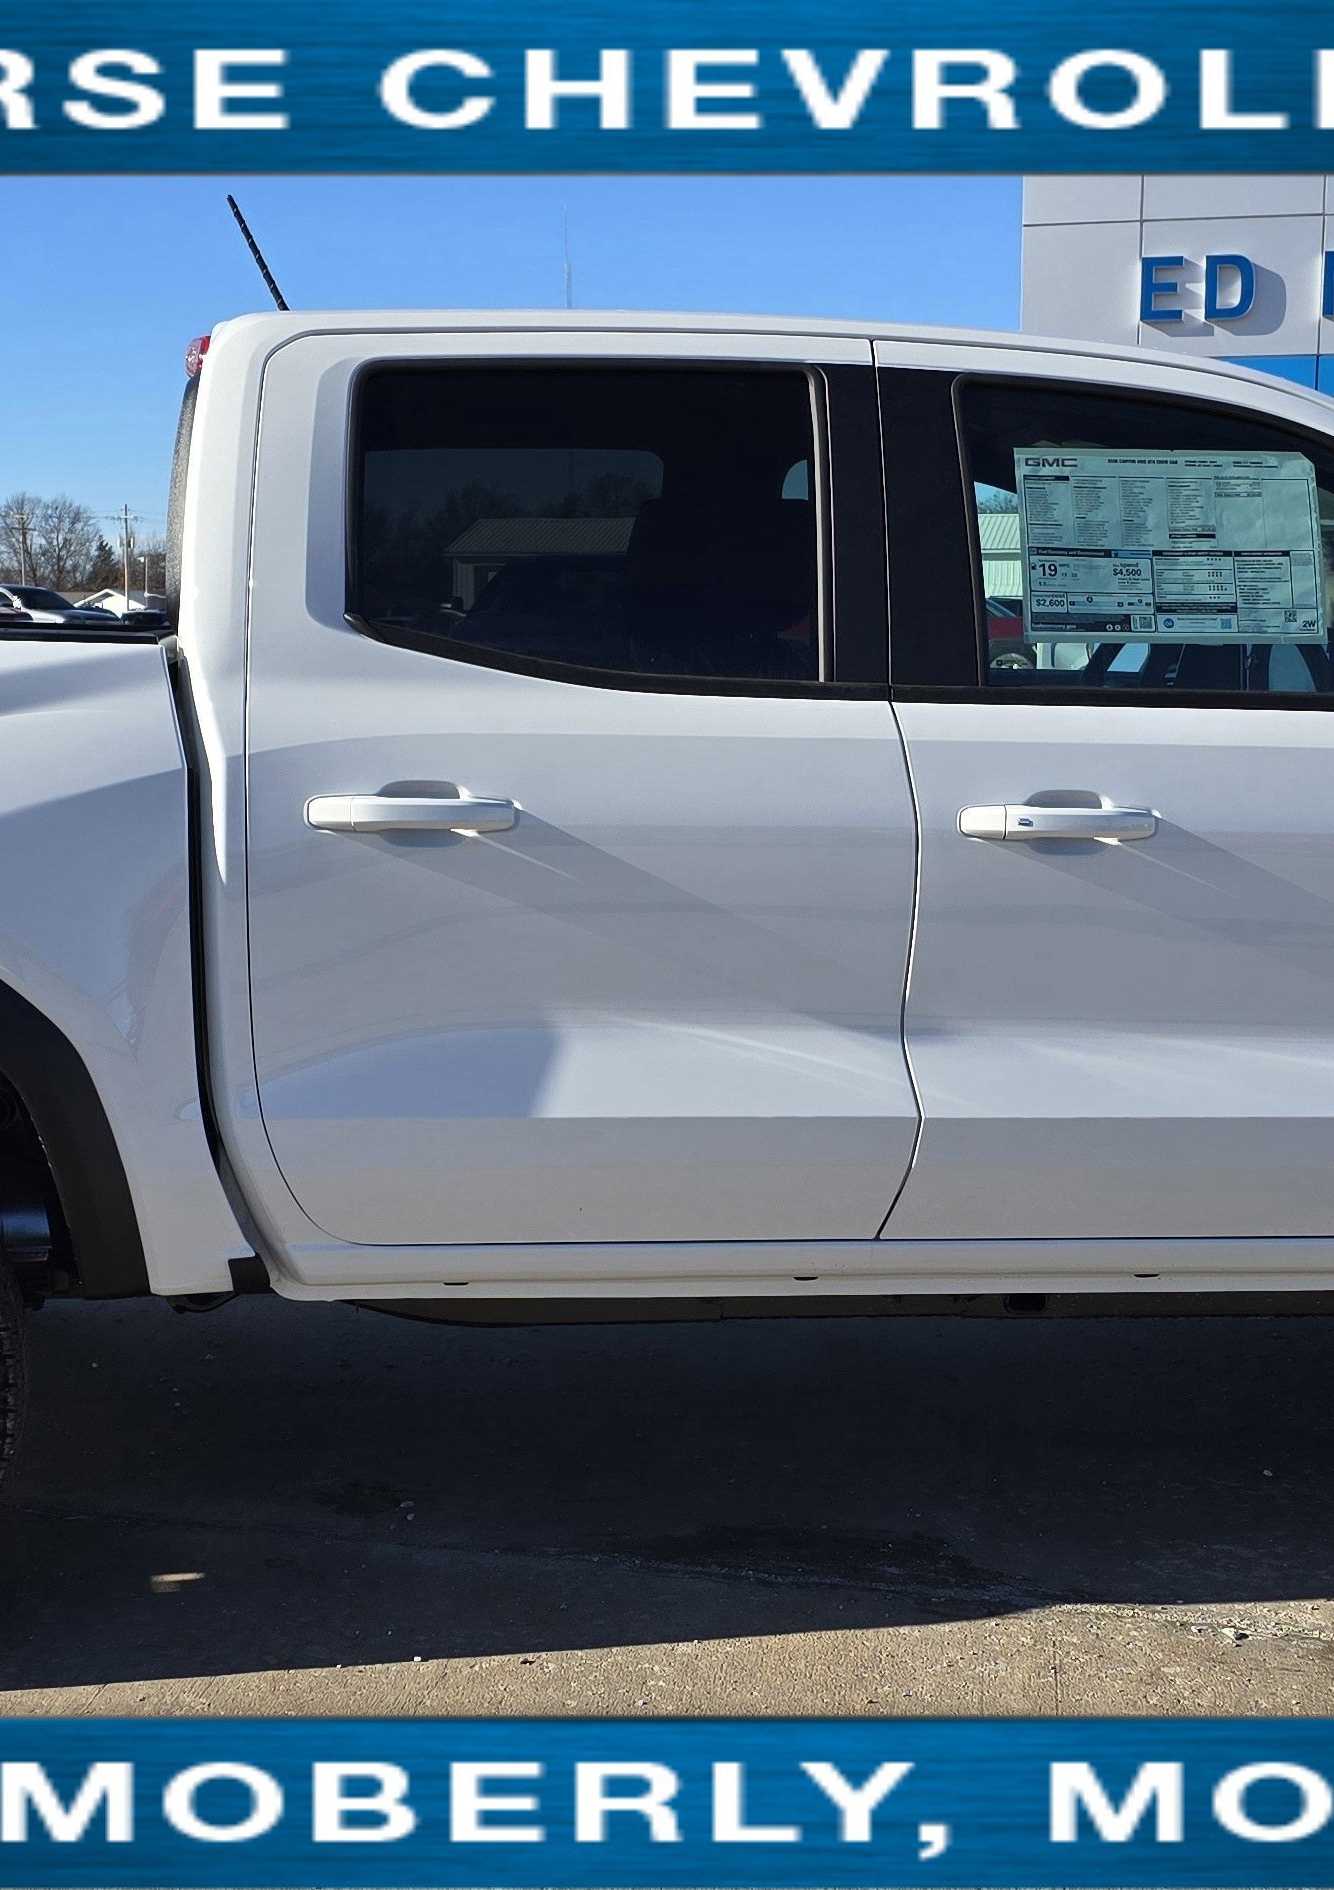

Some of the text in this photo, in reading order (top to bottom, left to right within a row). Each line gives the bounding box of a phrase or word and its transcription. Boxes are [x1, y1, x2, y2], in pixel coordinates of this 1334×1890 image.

[1139, 253, 1255, 322] ED
[1025, 457, 1078, 468] GMC
[1039, 563, 1058, 577] 19
[1113, 568, 1142, 577] $4,500
[1036, 598, 1065, 607] $2,600
[1302, 620, 1316, 628] 2W
